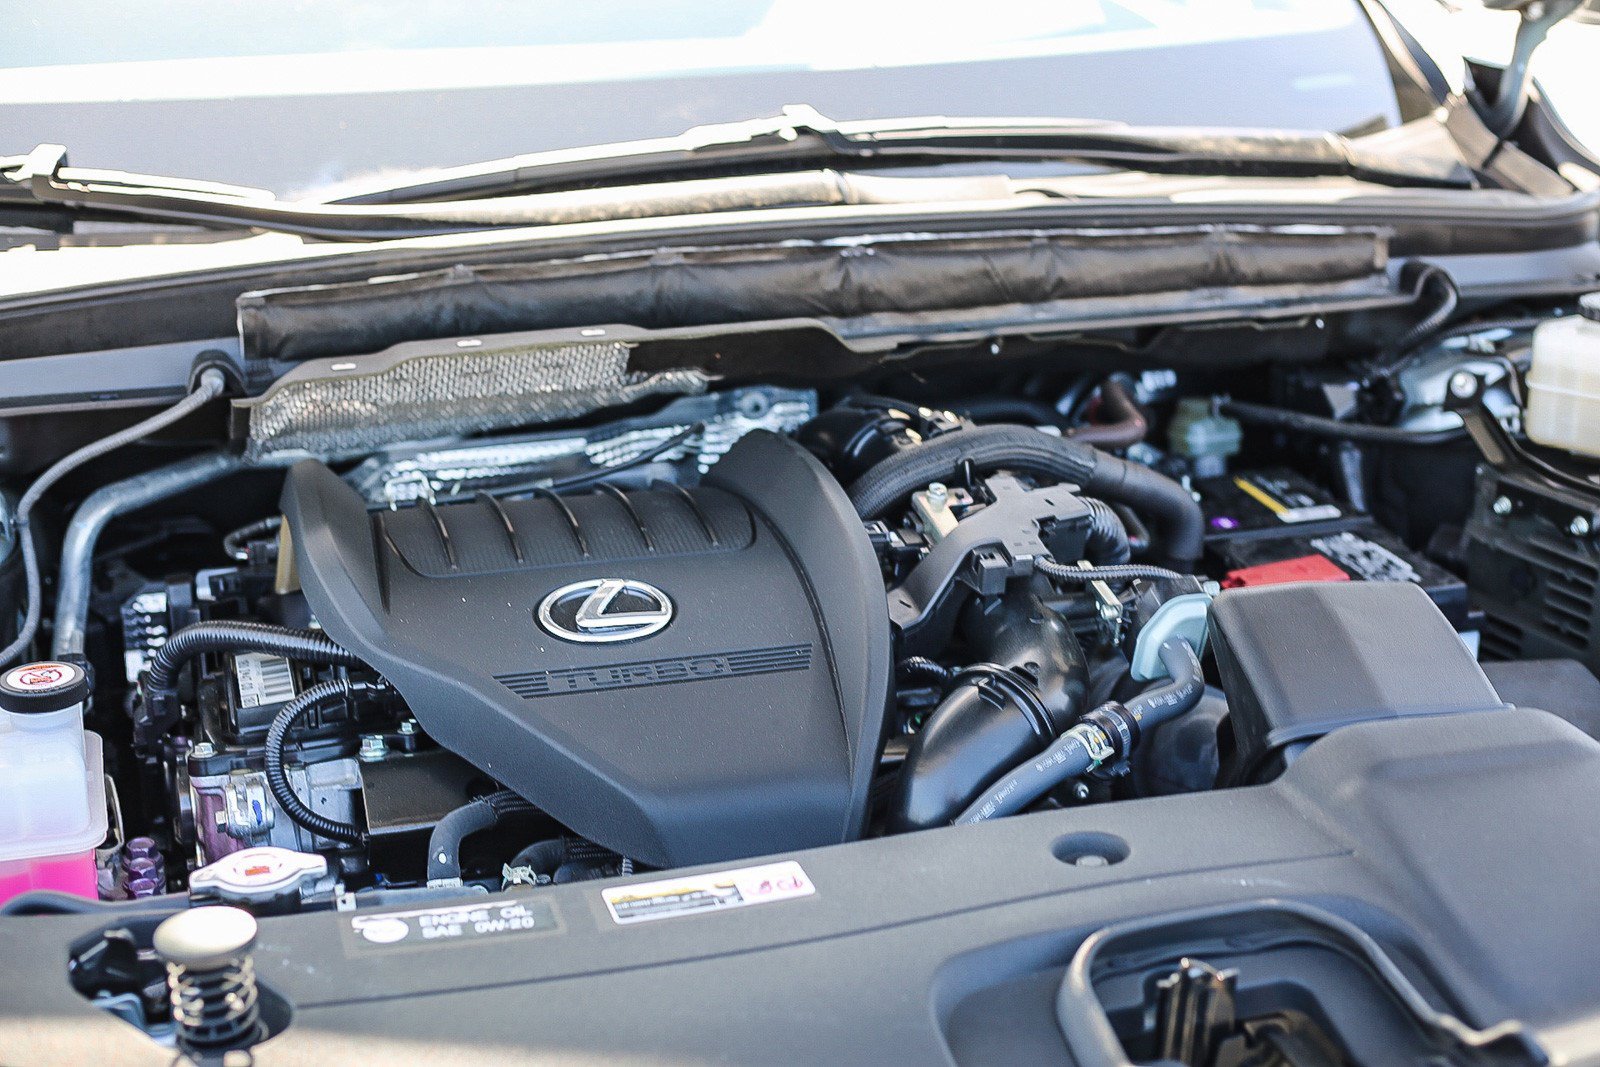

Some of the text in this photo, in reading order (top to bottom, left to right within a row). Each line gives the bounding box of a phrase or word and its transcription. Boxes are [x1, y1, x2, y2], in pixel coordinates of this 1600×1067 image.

[550, 656, 728, 690] TURBO
[419, 910, 490, 928] ENGINE
[422, 923, 462, 939] SAE
